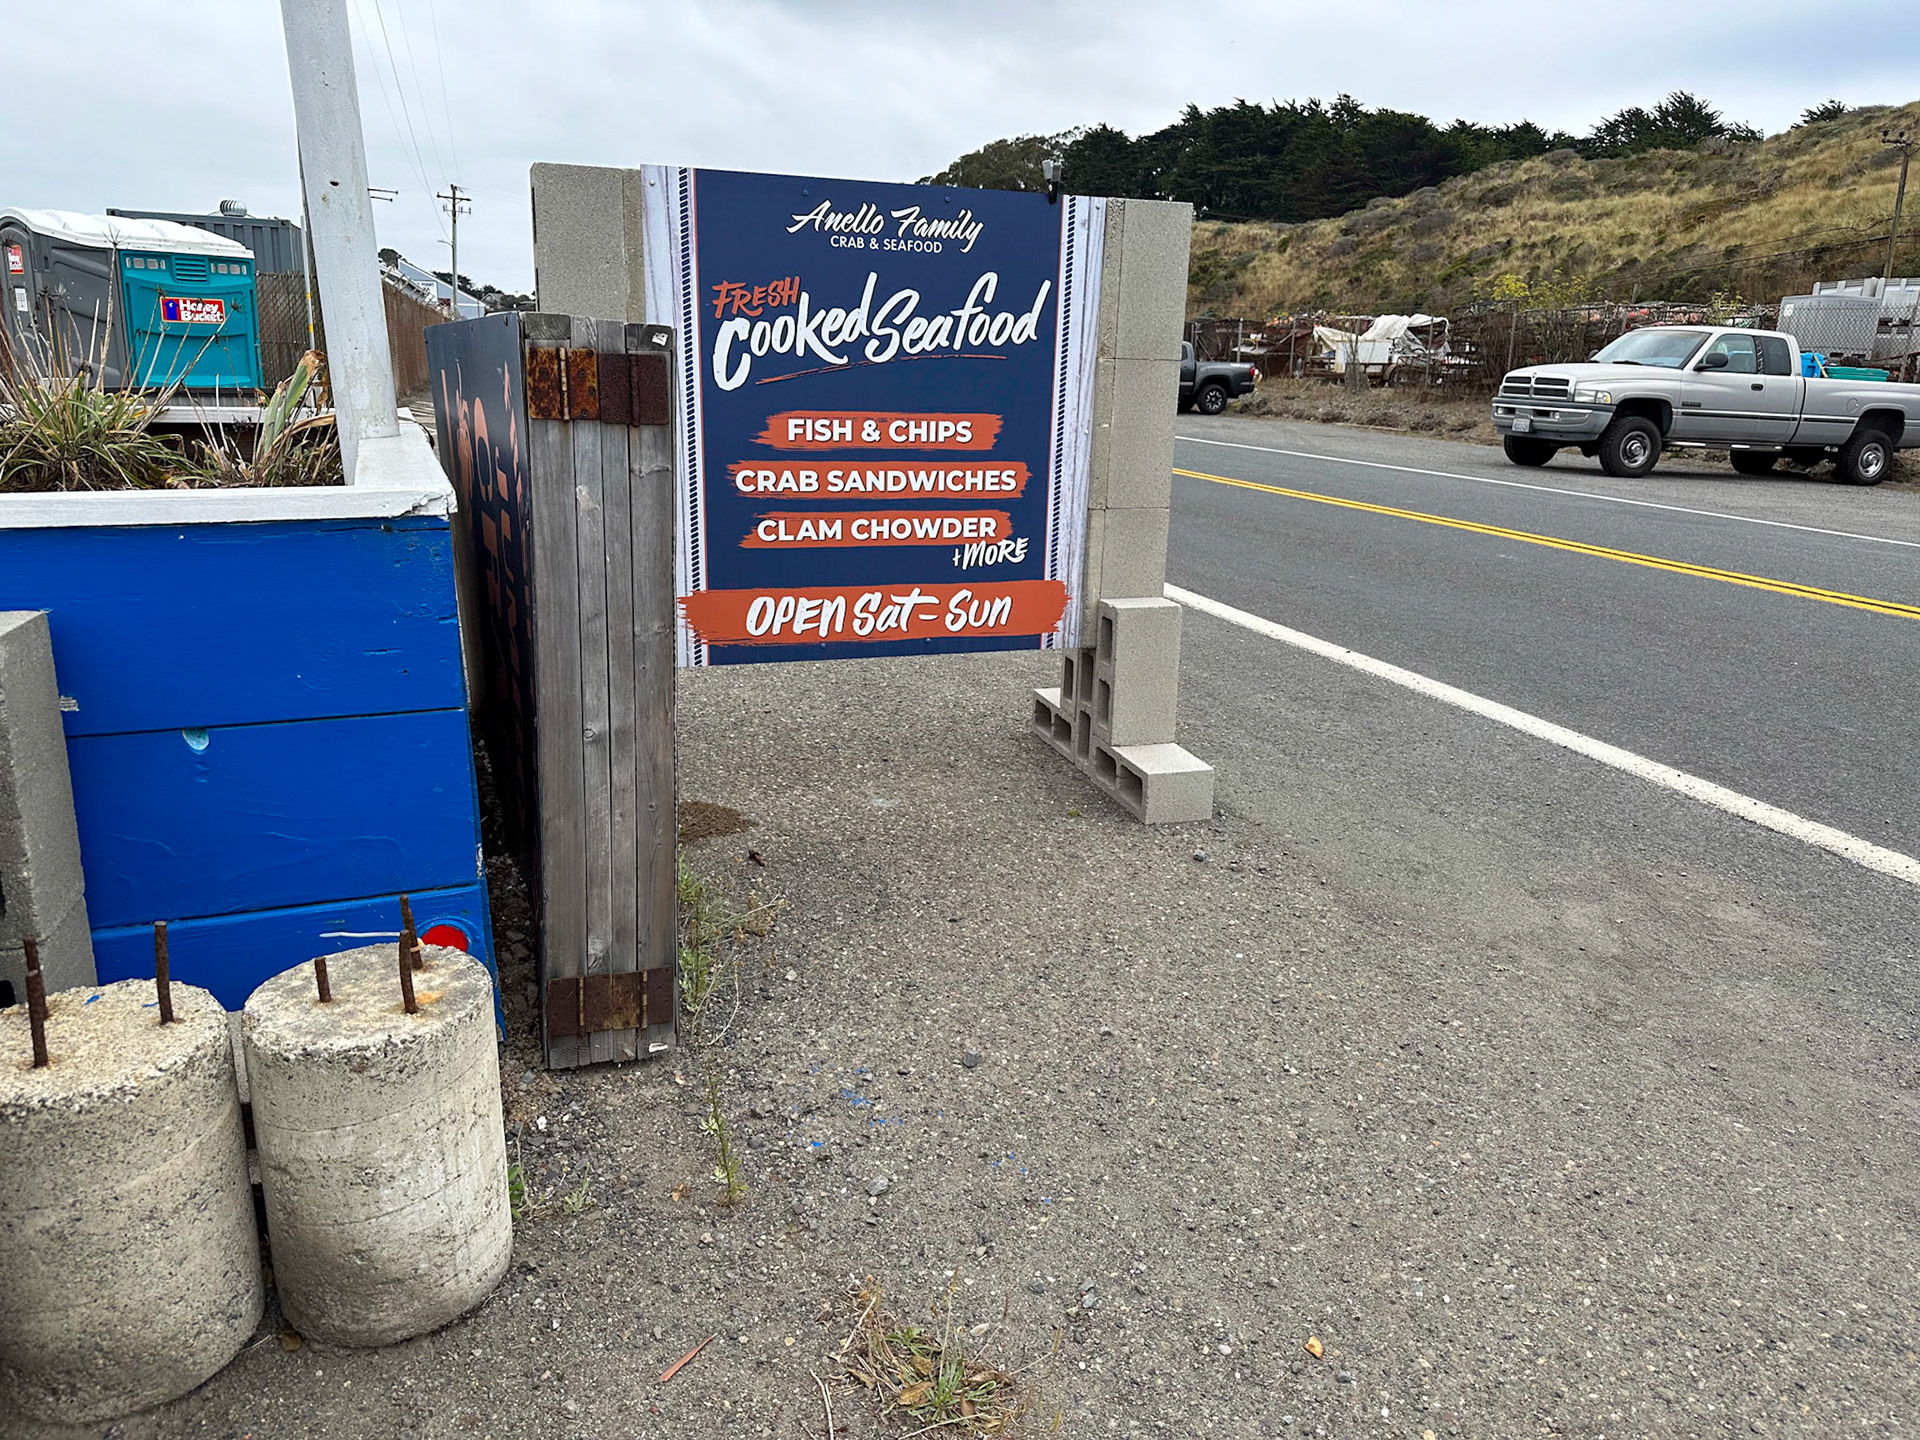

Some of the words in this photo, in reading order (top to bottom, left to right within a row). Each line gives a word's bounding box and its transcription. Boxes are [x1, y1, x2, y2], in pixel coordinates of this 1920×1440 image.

[787, 199, 885, 234] Anello
[890, 206, 984, 253] Family
[830, 235, 865, 250] CRAB
[869, 237, 879, 250] &
[883, 238, 943, 253] SEAFOOD
[712, 275, 801, 319] FRESH
[180, 310, 223, 322] Bucket
[713, 271, 878, 391] Cooked
[864, 271, 1051, 363] Seafood
[787, 418, 852, 441] FISH
[861, 418, 881, 442] &
[888, 420, 973, 443] CHIPS
[735, 470, 819, 493] CRAB
[826, 470, 1017, 492] SANDWICHES
[756, 519, 842, 541] CLAM
[851, 517, 997, 540] CHOWDER
[745, 595, 846, 637] OPEN
[944, 589, 1012, 632] Sun
